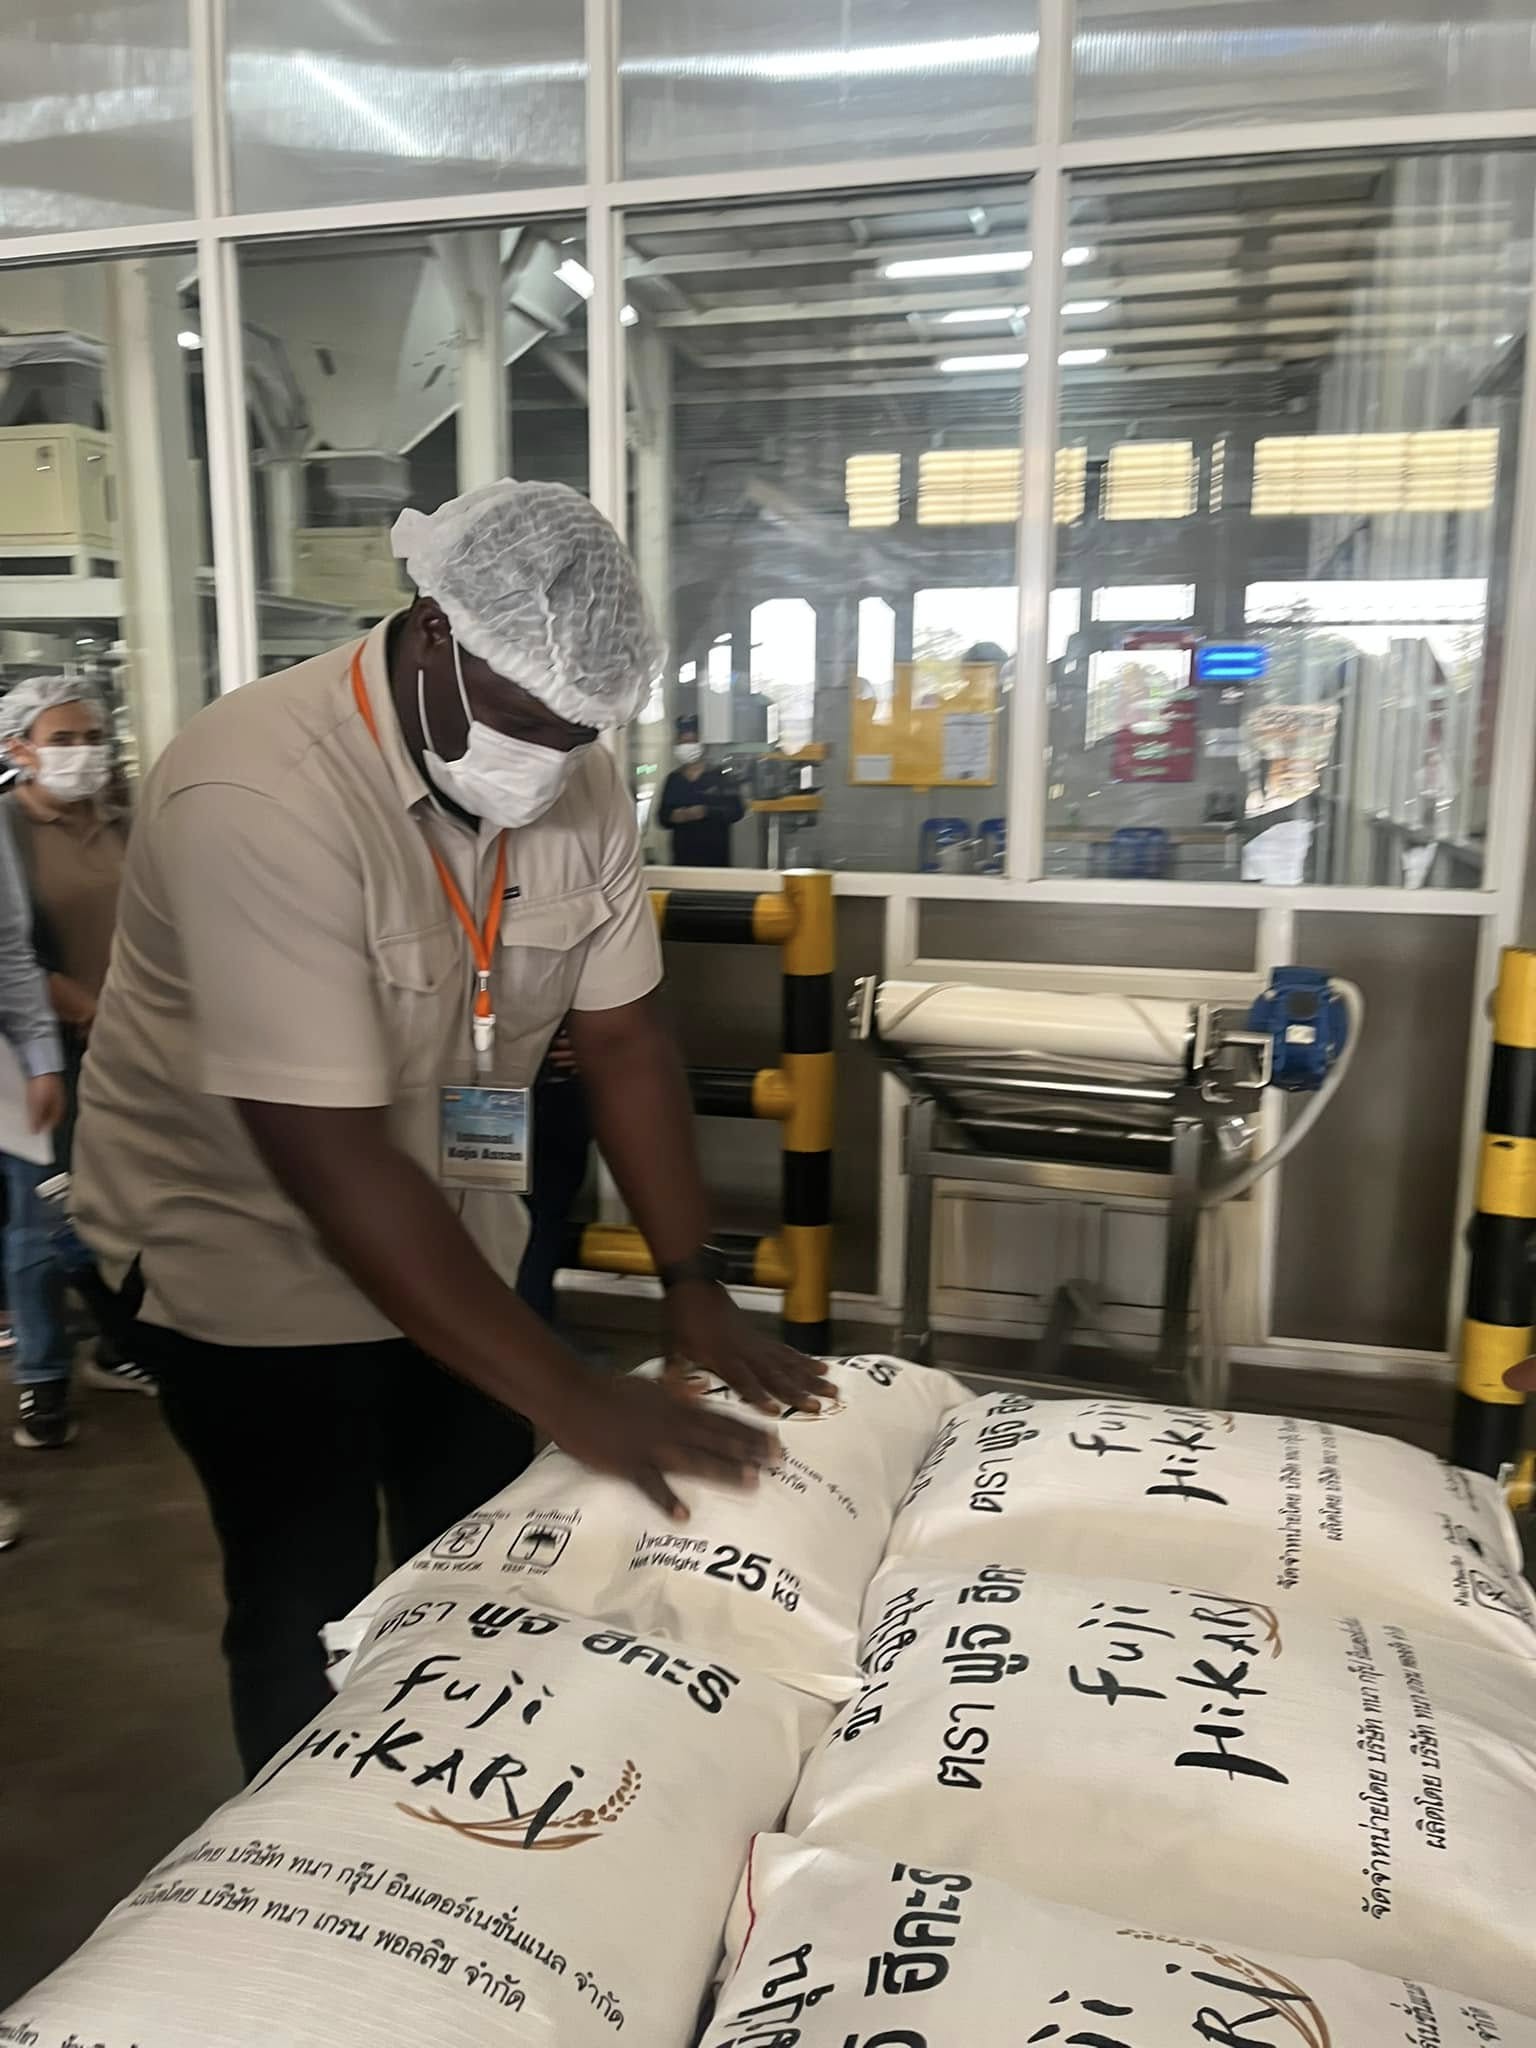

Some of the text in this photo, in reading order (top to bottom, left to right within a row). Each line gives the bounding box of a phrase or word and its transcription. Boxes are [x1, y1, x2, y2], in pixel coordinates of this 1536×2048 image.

[970, 1457, 1014, 1513] ตรา
[651, 1552, 700, 1572] Weight
[704, 1545, 772, 1593] 25
[771, 1581, 800, 1612] kg
[582, 1629, 741, 1714] ฮิคะริ
[937, 1704, 996, 1790] ตรา
[1356, 1718, 1387, 1764] บริษัท
[1409, 1724, 1441, 1770] บริษัท
[1358, 1768, 1392, 1919] จัดจำหน่ายโดย
[1413, 1774, 1447, 1850] ผลิตโดย
[198, 1882, 260, 1915] บริษัท
[261, 1900, 309, 1926] ทนา
[312, 1912, 370, 1942] เกรน
[374, 1929, 459, 1975] พอลลิช
[464, 1961, 527, 2013] จำกัด
[226, 1840, 285, 1869] บริษัท
[288, 1855, 333, 1880] ทนา
[385, 1872, 568, 1975] อินเตอร์เนชั่นแนล
[574, 1971, 625, 2032] จำกัด
[864, 1862, 973, 1998] ฮิคะริ
